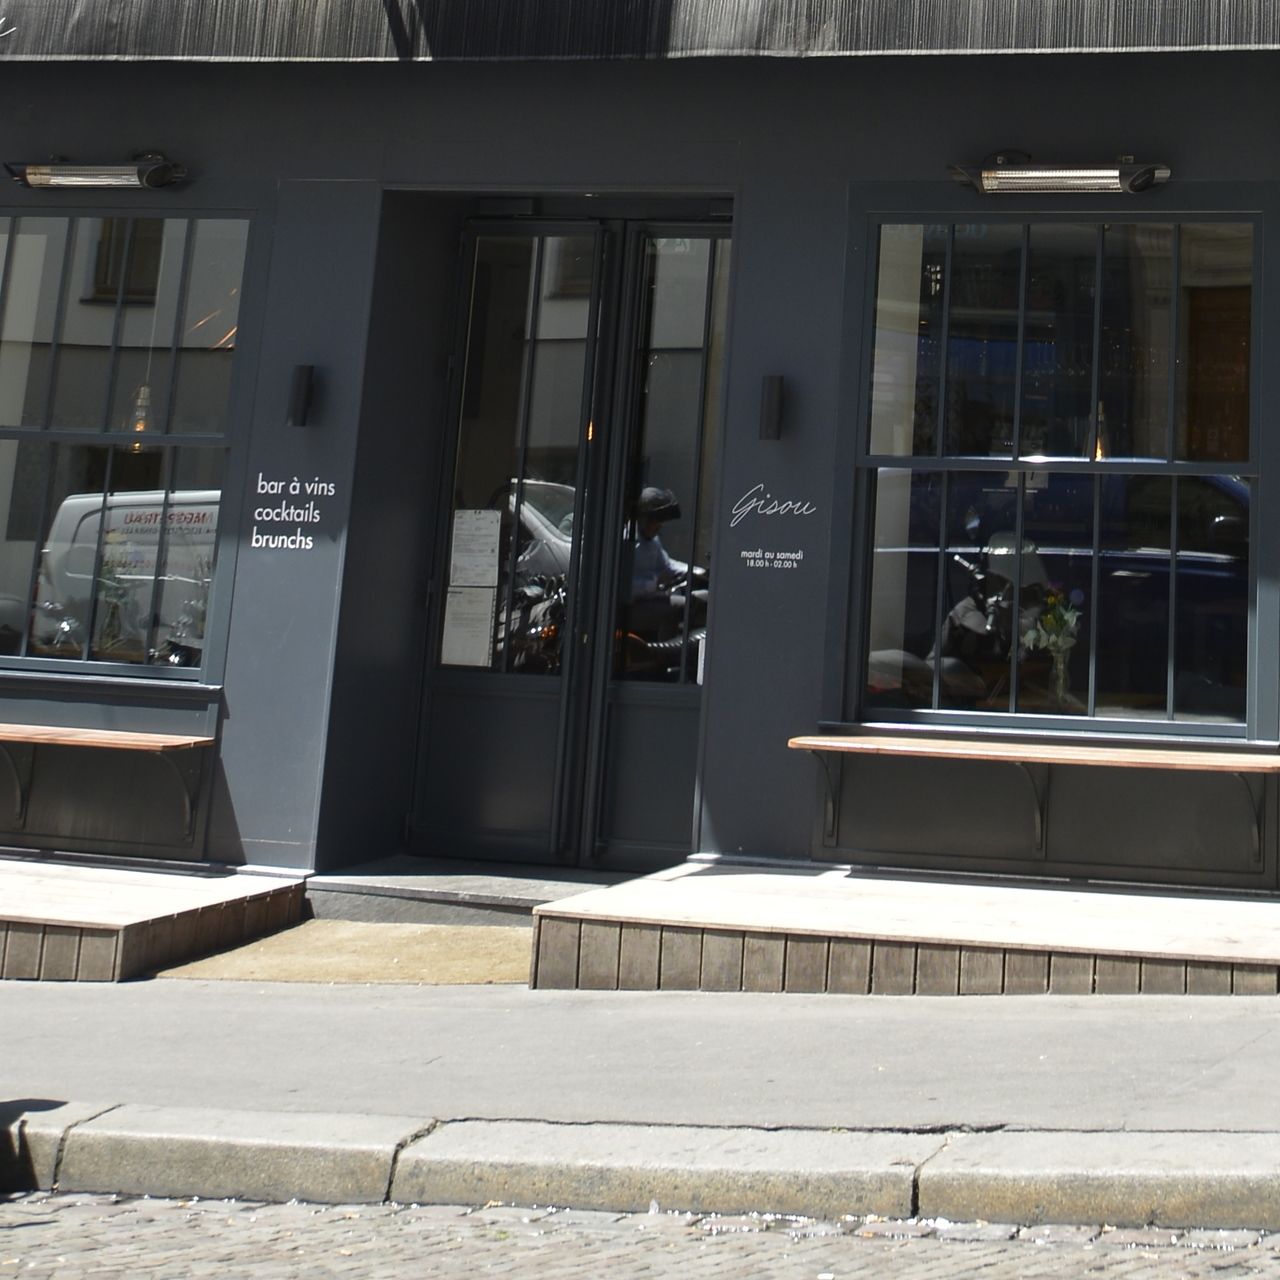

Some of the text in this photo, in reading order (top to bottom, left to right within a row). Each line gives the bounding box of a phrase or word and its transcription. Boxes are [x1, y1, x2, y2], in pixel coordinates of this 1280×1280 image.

[257, 472, 335, 496] bar à vins
[254, 500, 321, 522] cocktails
[730, 483, 816, 527] Gisou
[251, 526, 313, 550] brunchs
[741, 548, 804, 560] mardi au samedi
